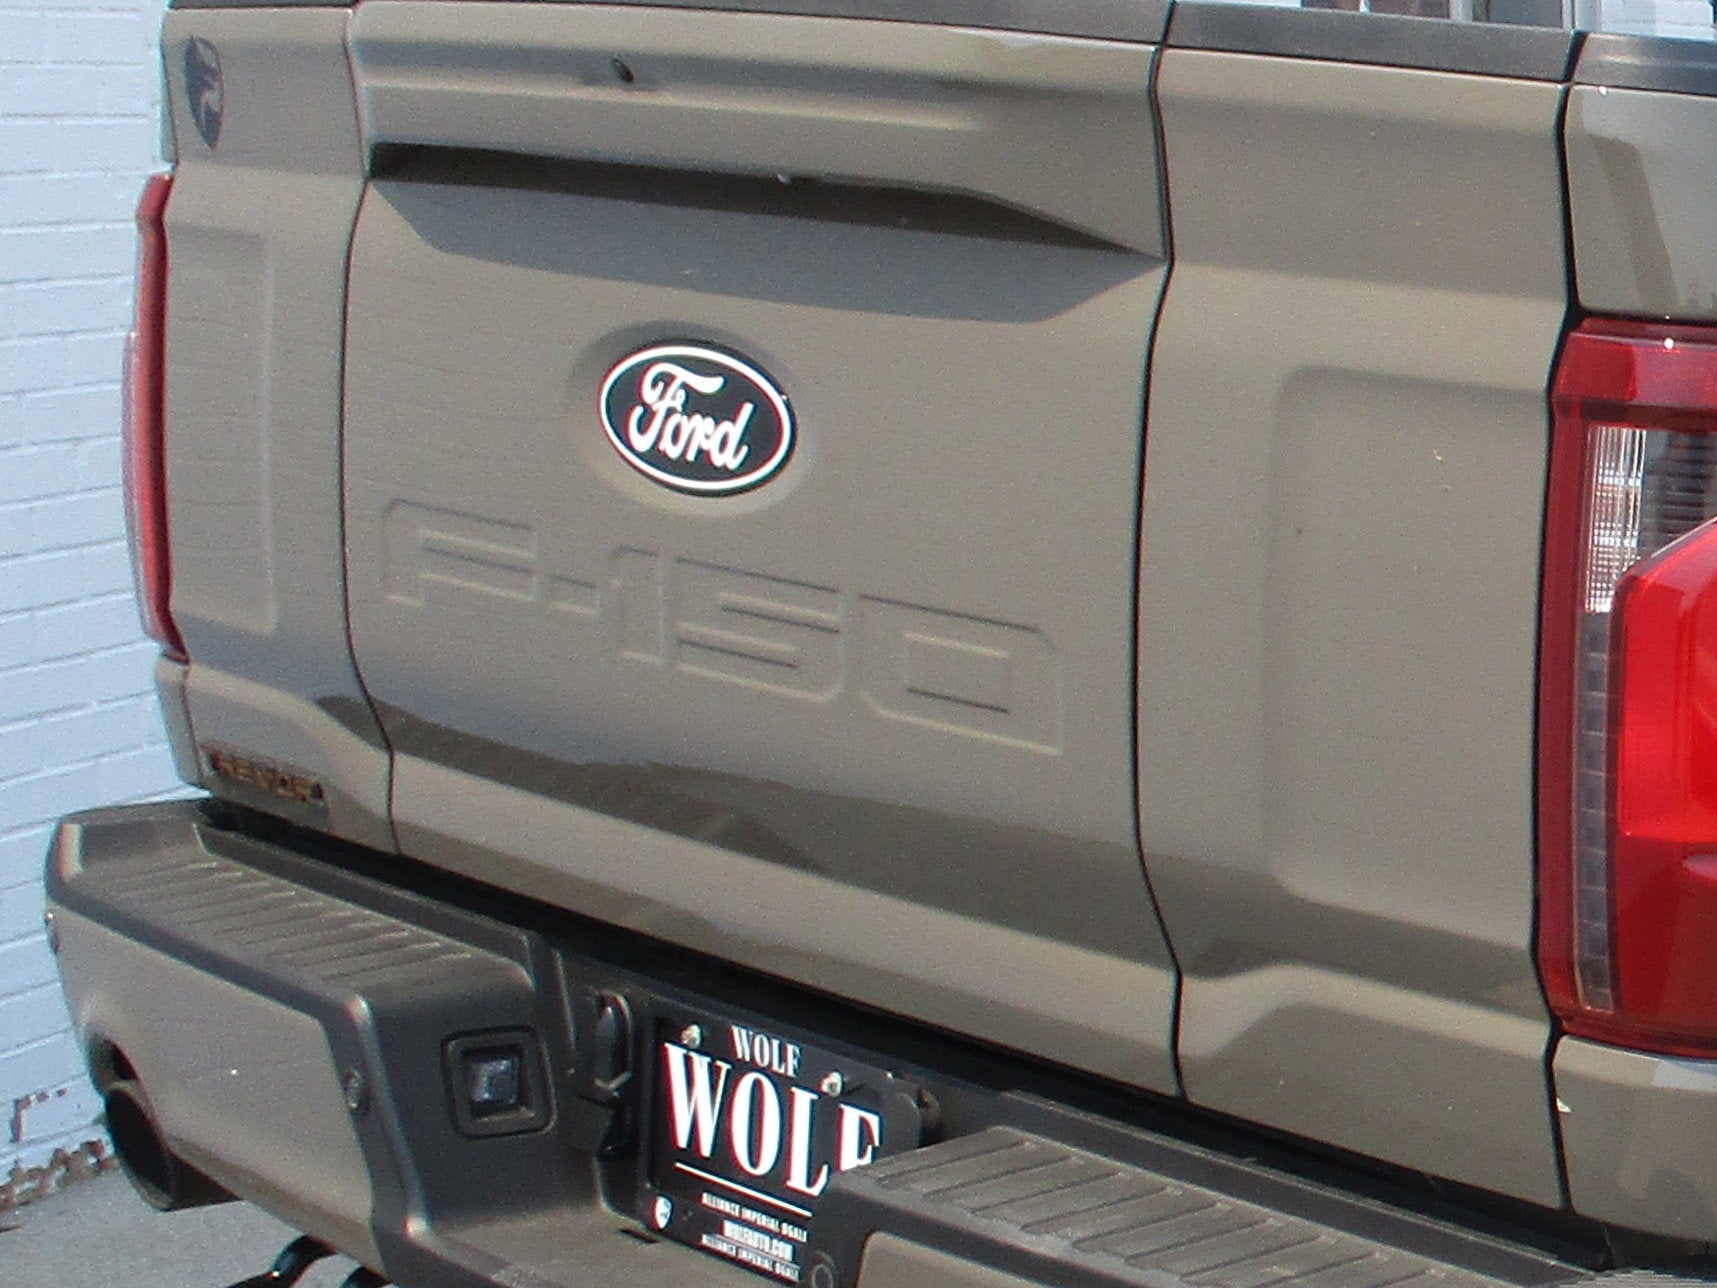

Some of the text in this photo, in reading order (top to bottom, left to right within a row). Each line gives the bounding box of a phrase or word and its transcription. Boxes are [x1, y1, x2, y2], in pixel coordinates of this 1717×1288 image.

[628, 362, 750, 470] Ford
[379, 497, 1063, 757] F-150
[731, 1024, 802, 1079] WOLF
[663, 1042, 882, 1198] WOLF
